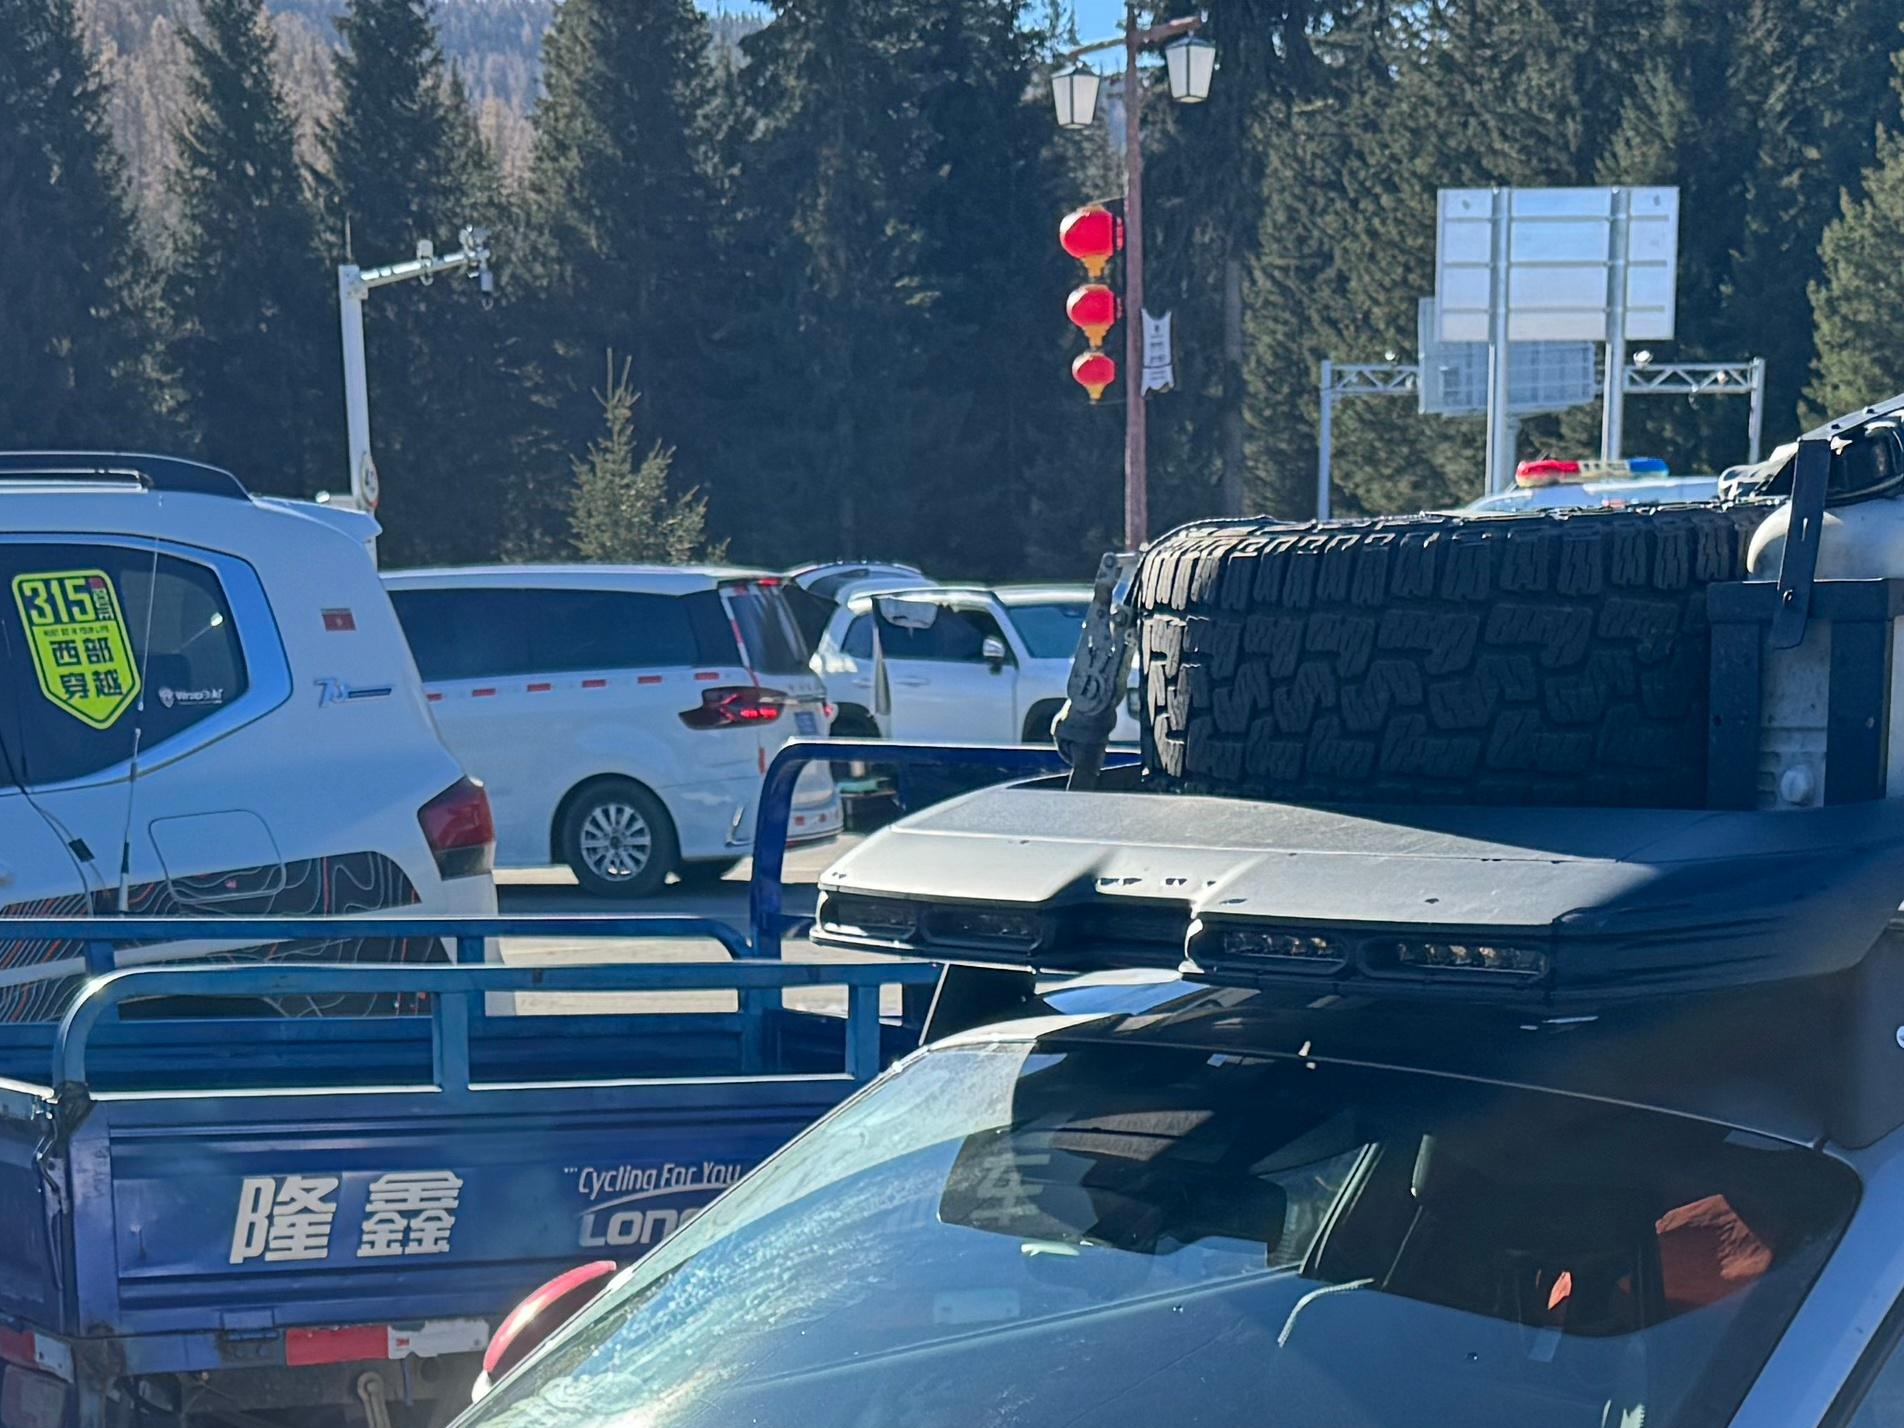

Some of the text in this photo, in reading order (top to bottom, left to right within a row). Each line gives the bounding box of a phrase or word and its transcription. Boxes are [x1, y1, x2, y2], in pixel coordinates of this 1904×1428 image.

[22, 578, 96, 625] 315
[49, 636, 115, 668] 西部
[60, 669, 125, 702] 穿越
[659, 1162, 698, 1188] For
[702, 1161, 741, 1186] You
[228, 1168, 465, 1266] 隆鑫
